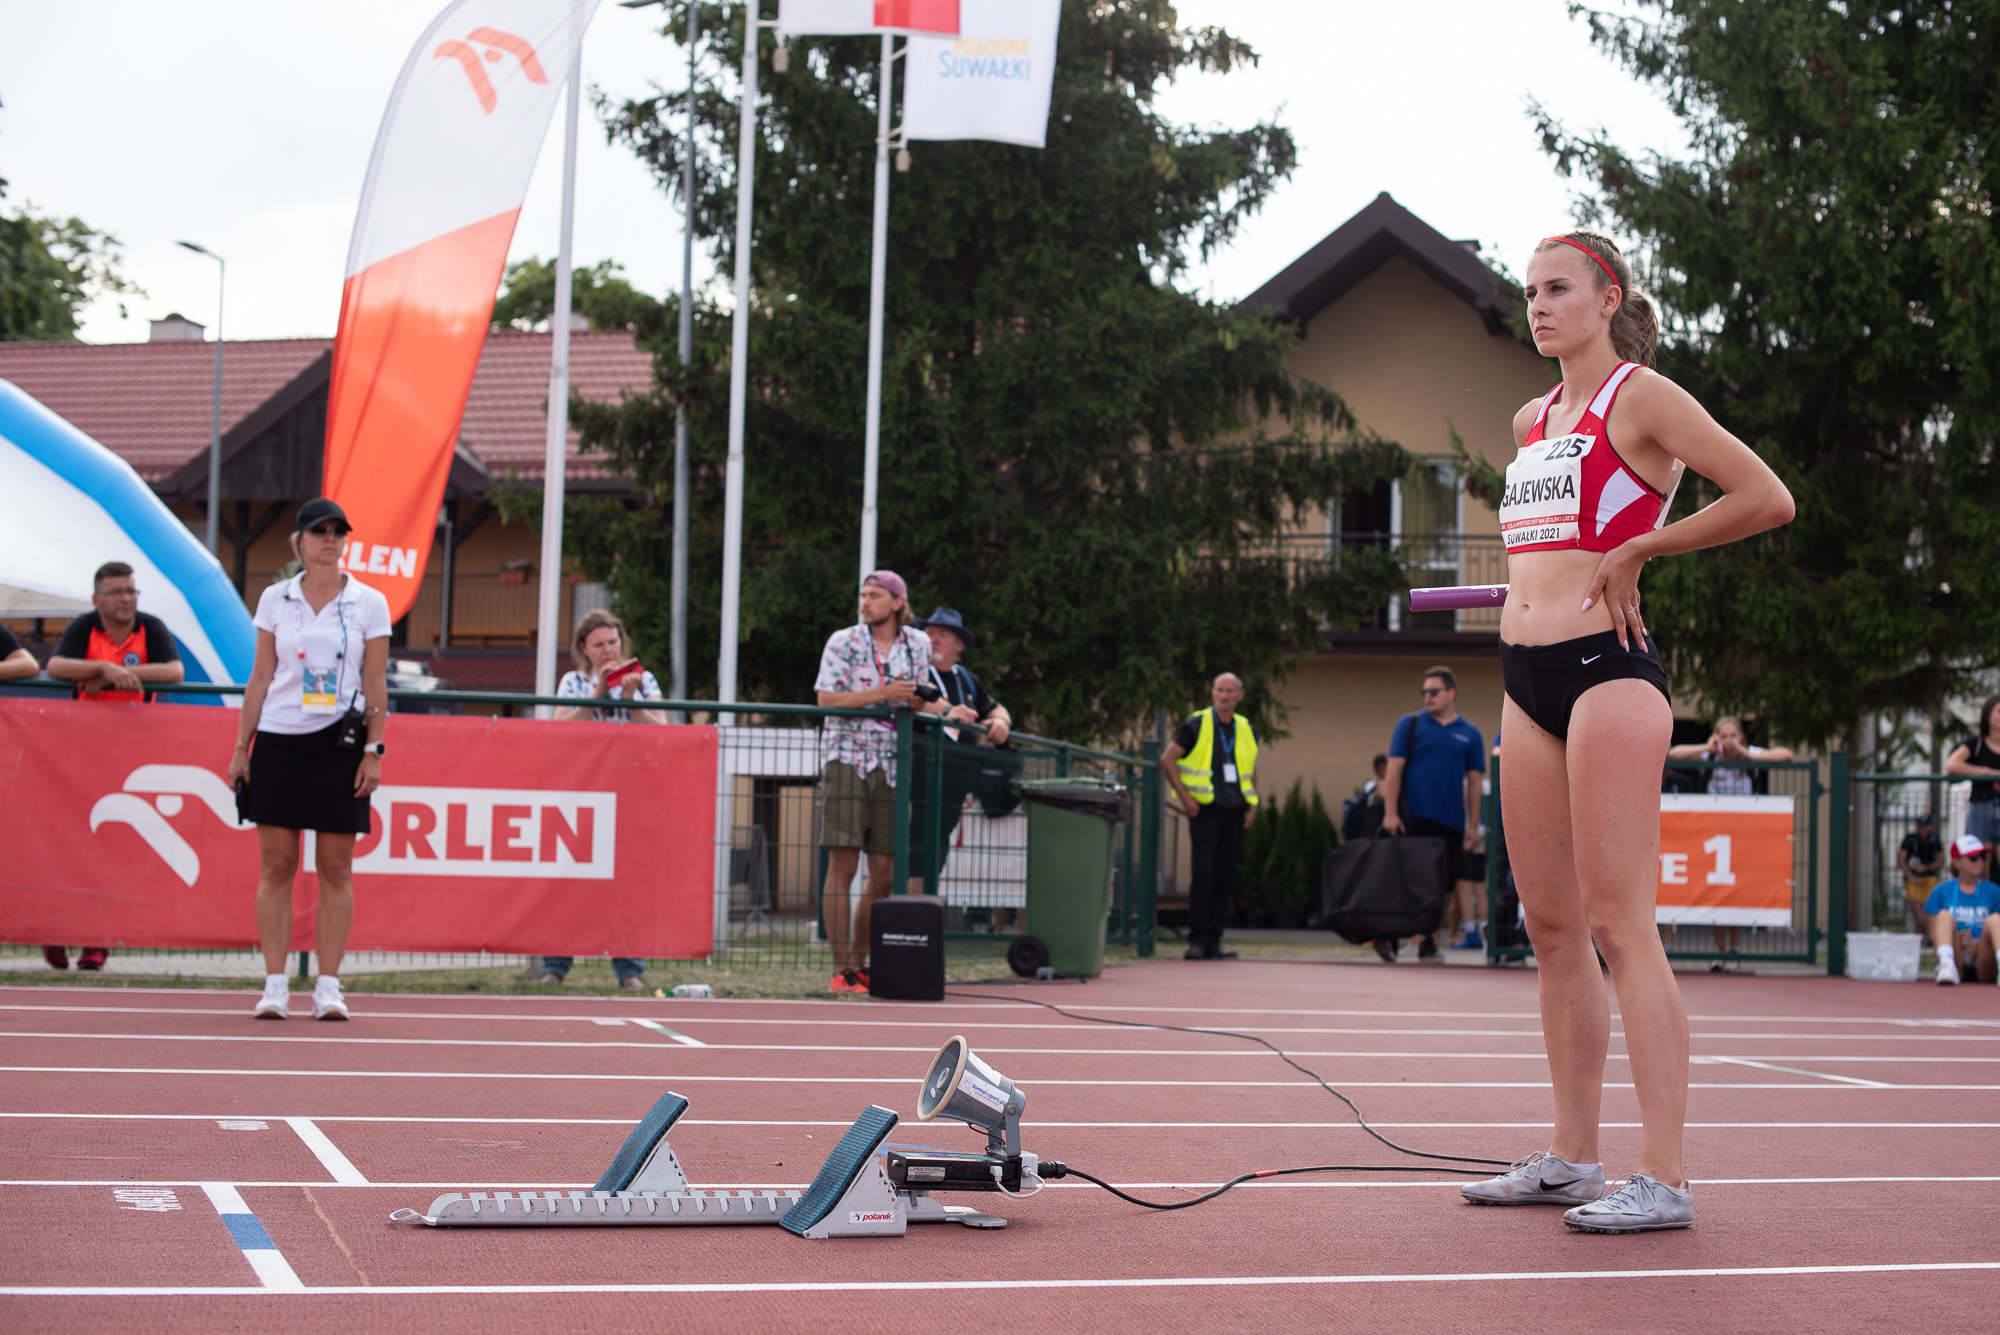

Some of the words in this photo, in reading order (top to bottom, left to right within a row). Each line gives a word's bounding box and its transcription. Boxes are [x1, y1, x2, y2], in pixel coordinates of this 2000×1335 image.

[1544, 437, 1587, 461] 225
[1502, 474, 1575, 508] GAJEWSKA
[1507, 530, 1538, 545] SUWAŁKI
[1540, 528, 1560, 540] 2021
[1490, 588, 1498, 598] 3
[1703, 834, 1736, 885] 1
[862, 1212, 892, 1222] polanik
